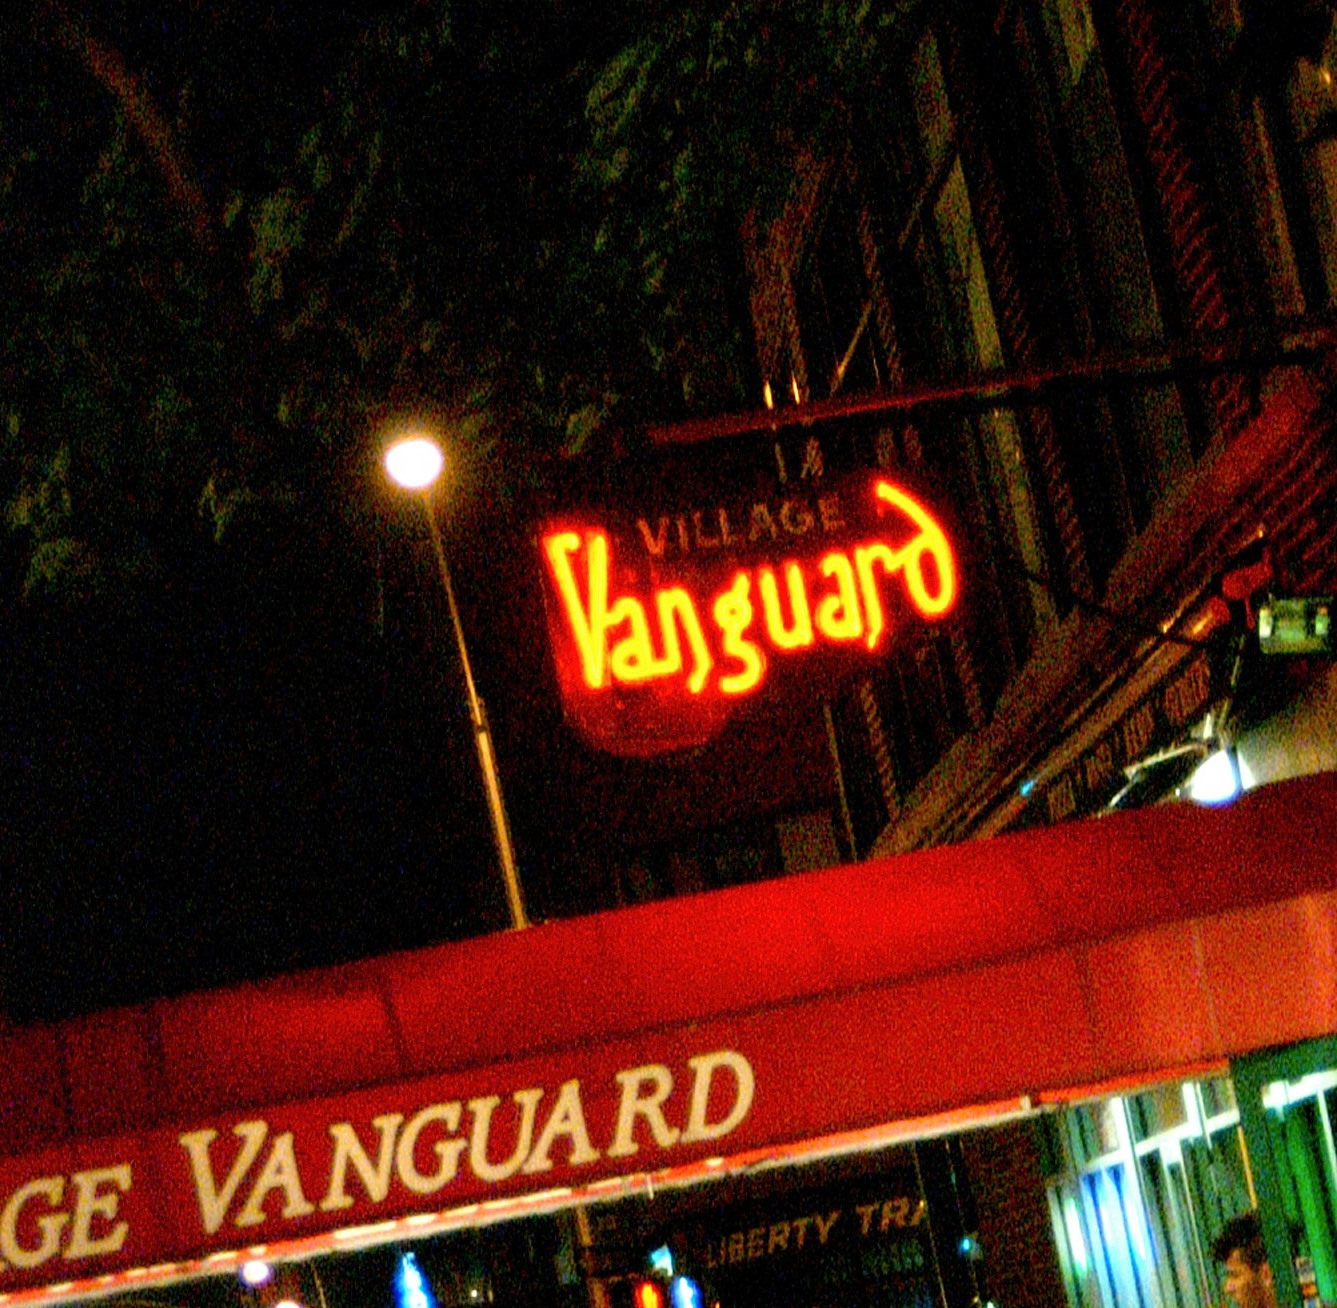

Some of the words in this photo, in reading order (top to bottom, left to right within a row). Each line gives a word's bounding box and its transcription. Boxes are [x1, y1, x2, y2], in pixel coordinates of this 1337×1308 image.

[542, 478, 957, 694] Vanguard
[637, 495, 847, 556] VILLAGE
[178, 1048, 756, 1235] VANGUARD
[707, 1209, 842, 1269] LIBERTY
